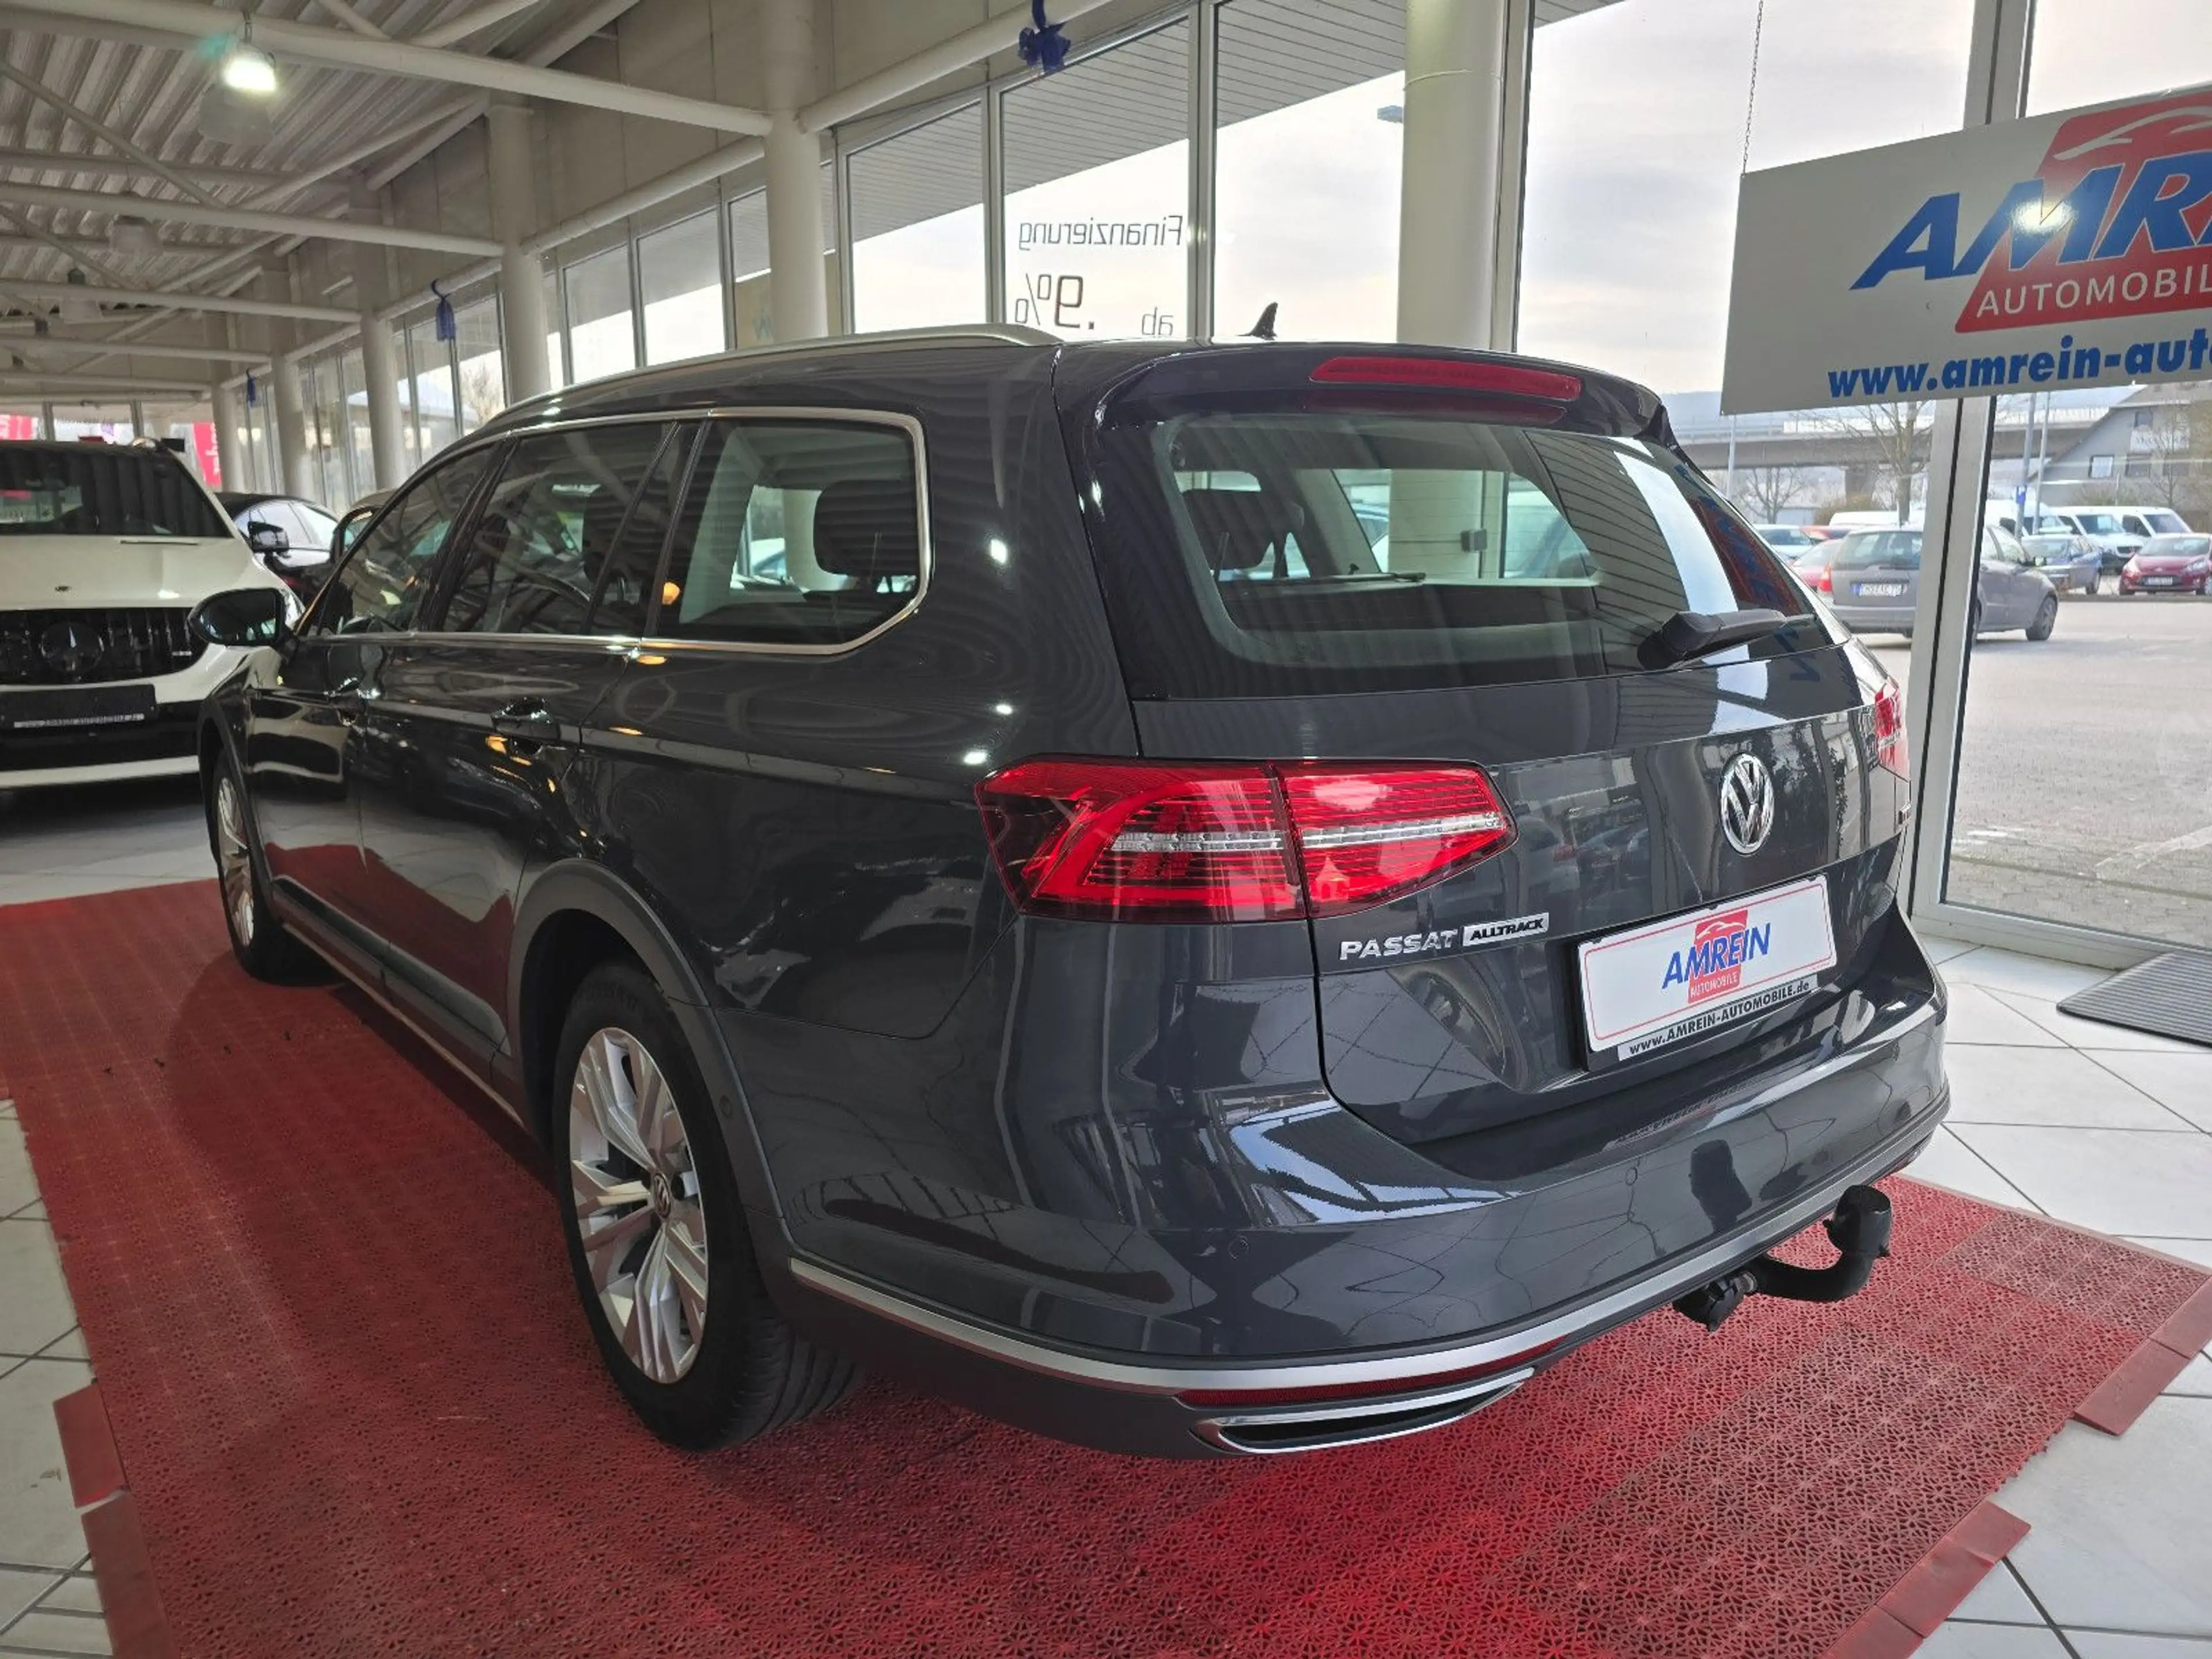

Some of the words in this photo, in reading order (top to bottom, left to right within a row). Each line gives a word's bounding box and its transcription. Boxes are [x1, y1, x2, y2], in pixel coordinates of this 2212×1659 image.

[1849, 149, 2212, 290] AMR
[1827, 328, 2212, 398] www.amrein-aut
[1339, 929, 1458, 961] PASSAT
[1469, 917, 1545, 941] ALLTRACK
[1661, 922, 1771, 989] AMREIN
[1629, 979, 1809, 1055] www.AMREIN-AUTOMOBILE.de
[1690, 971, 1738, 998] AUTOMOBILE
